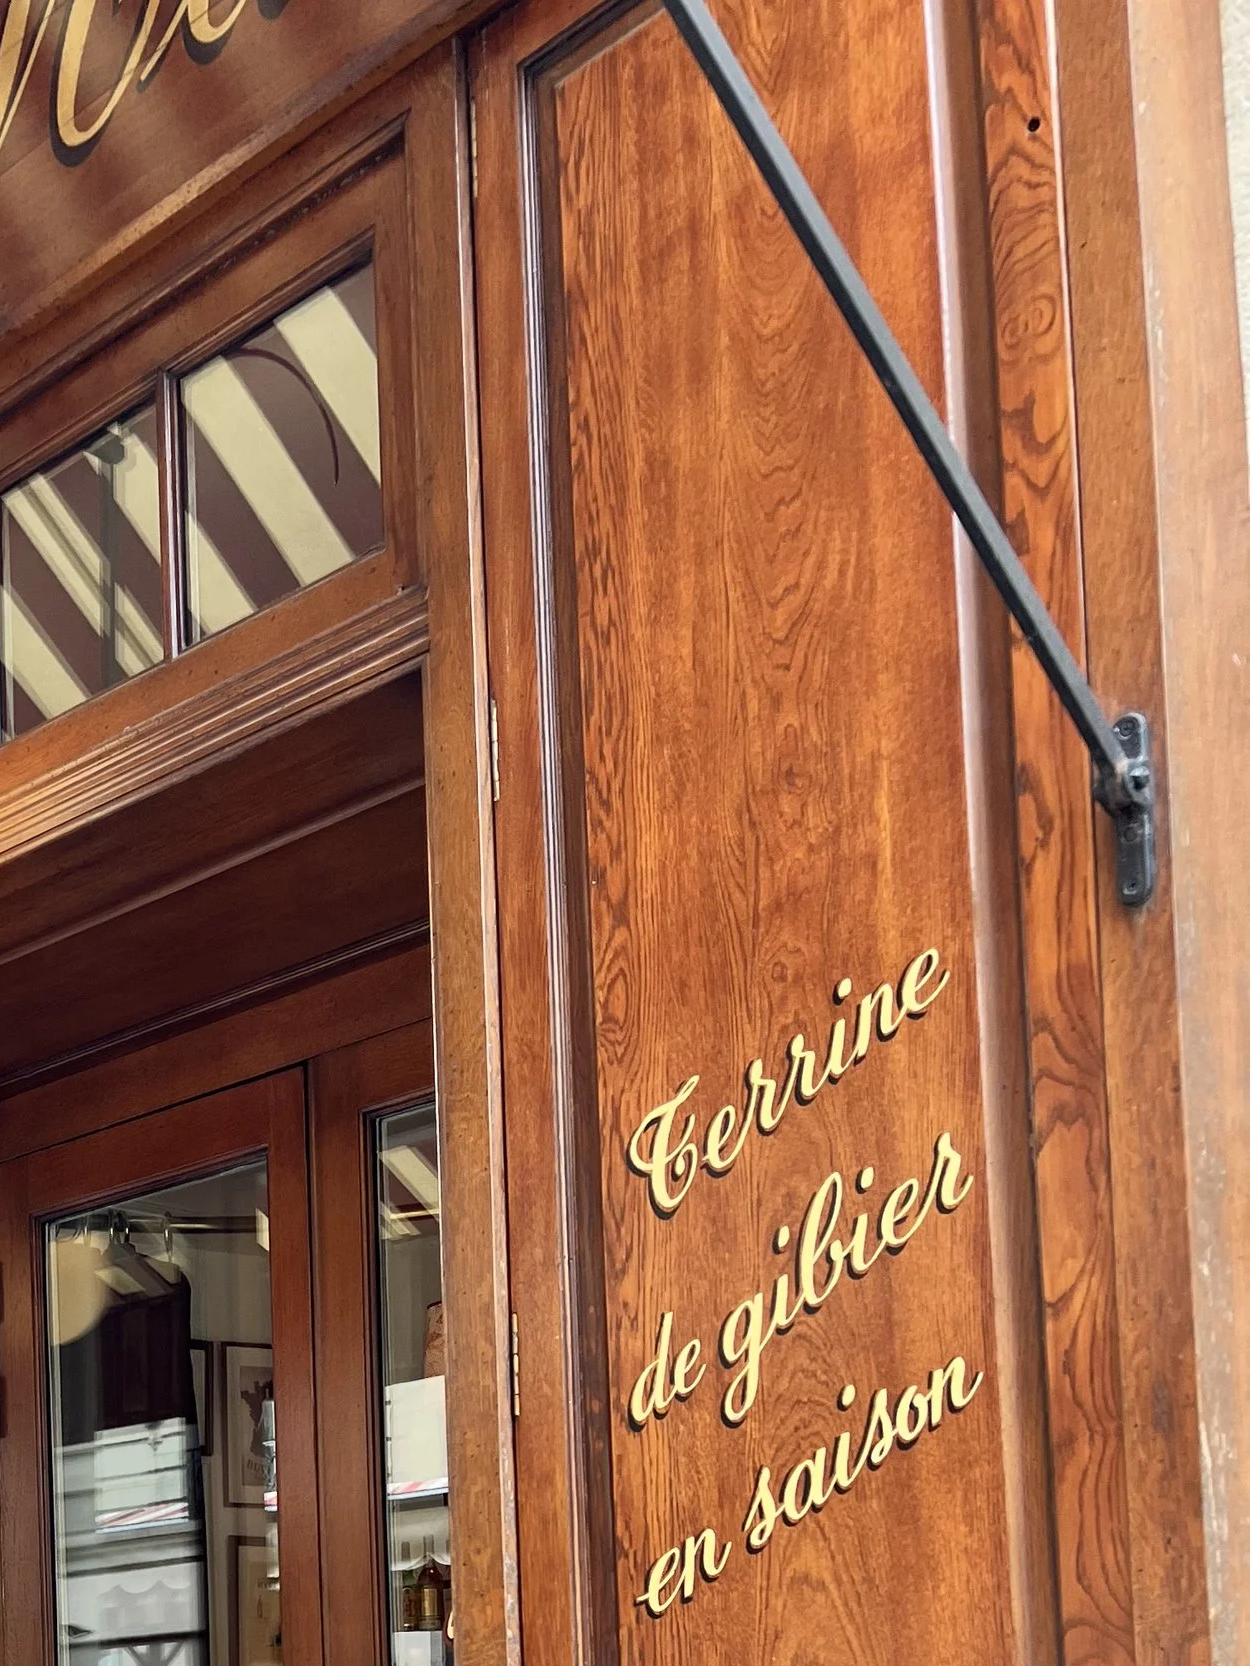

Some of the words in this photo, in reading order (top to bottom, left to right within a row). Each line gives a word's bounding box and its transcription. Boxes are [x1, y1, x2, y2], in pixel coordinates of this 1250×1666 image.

[630, 947, 950, 1212] Terrine
[631, 1311, 707, 1425] de
[722, 1132, 973, 1425] gibier
[636, 1526, 731, 1615] en
[745, 1356, 983, 1548] saison
